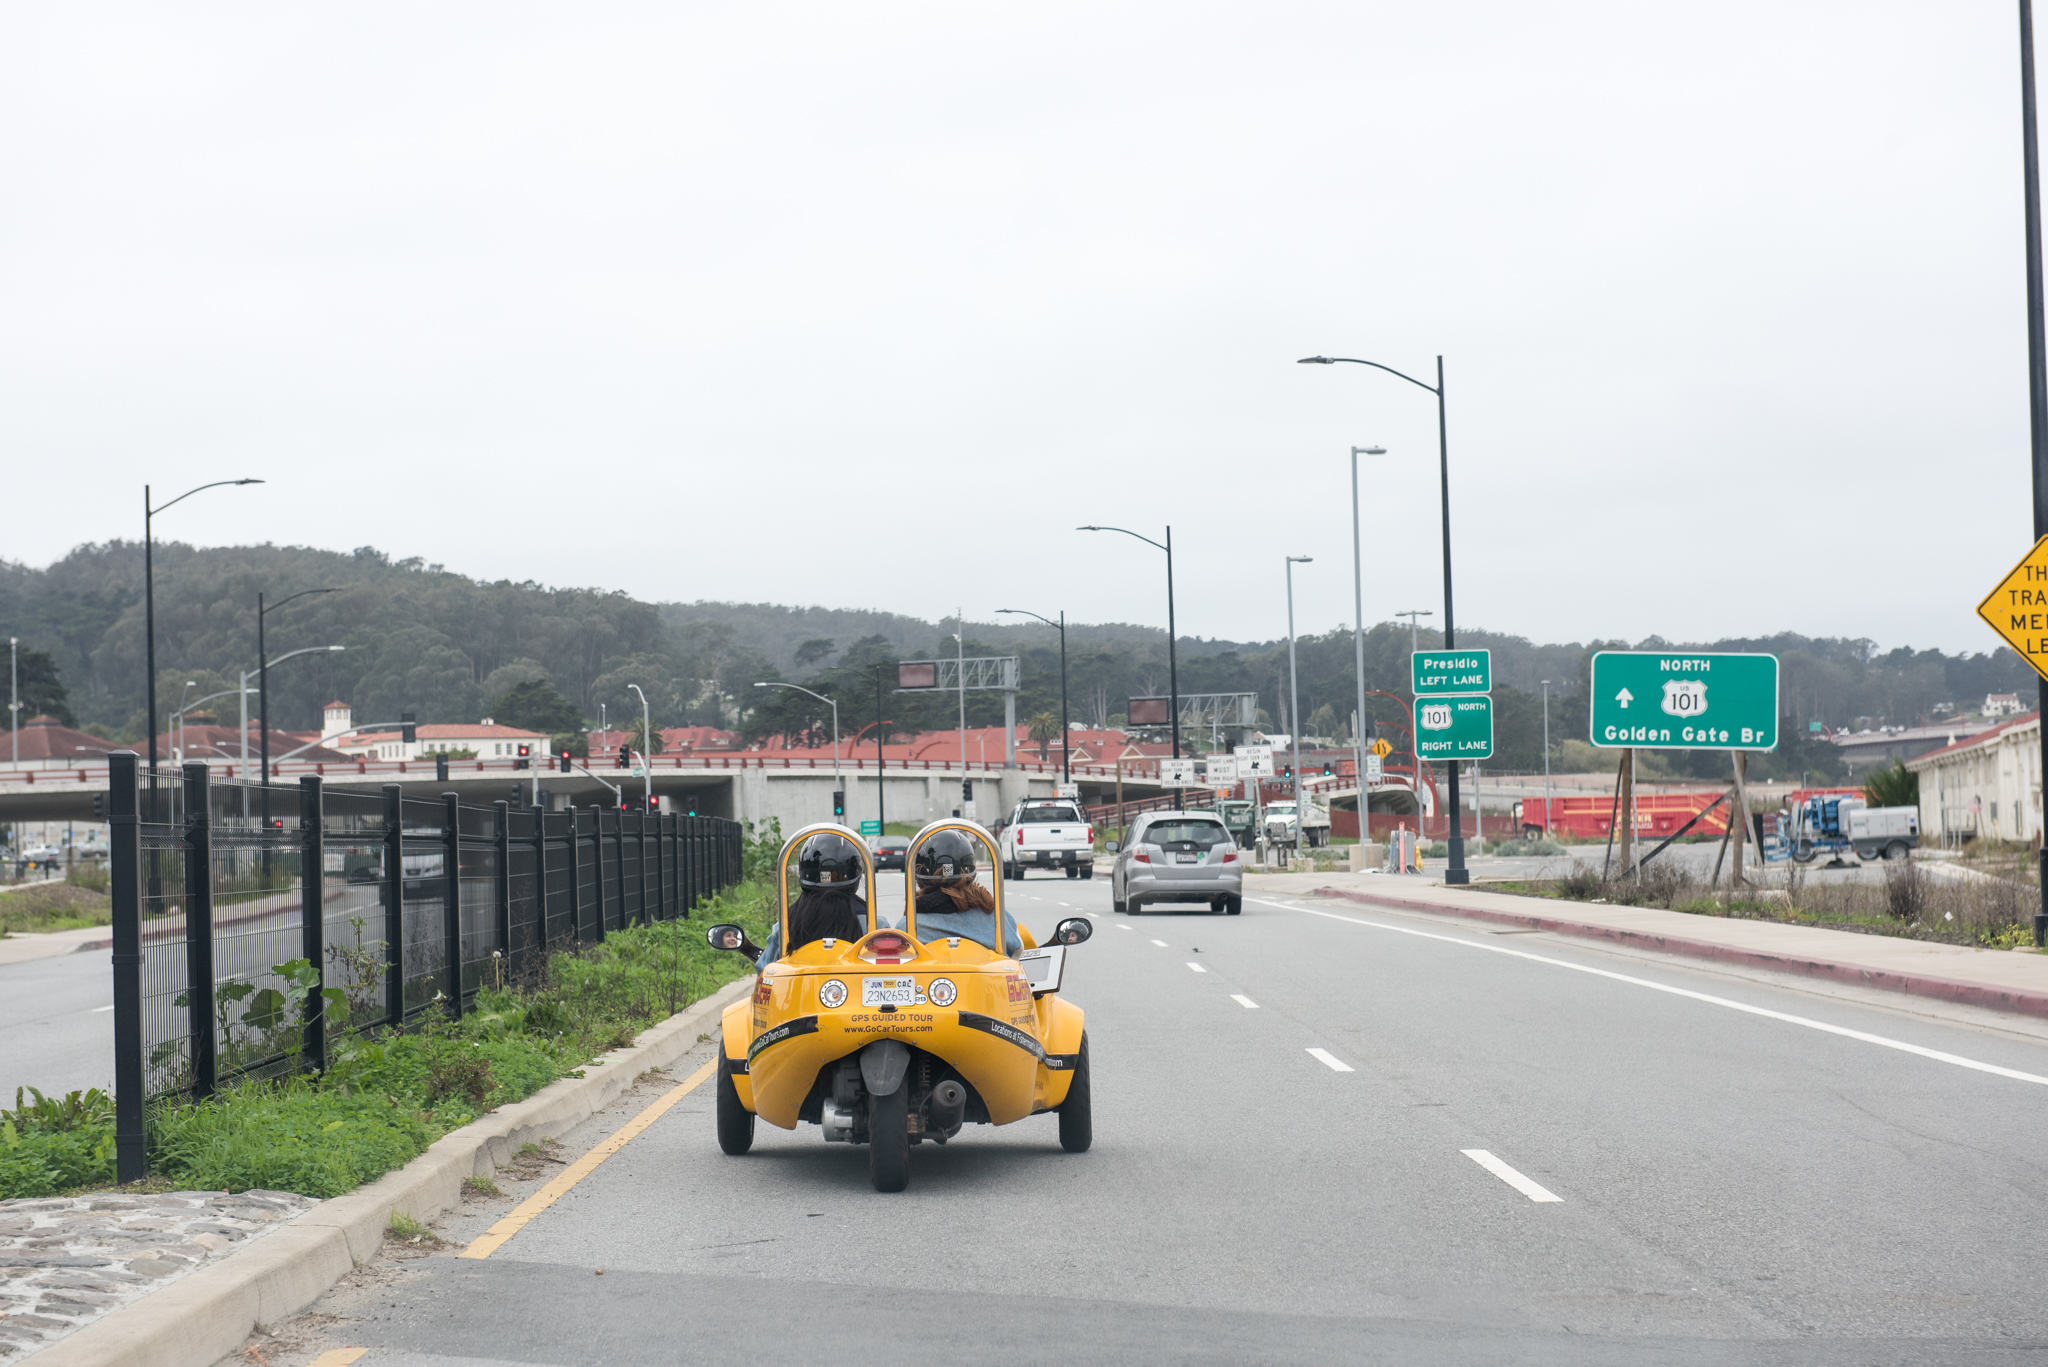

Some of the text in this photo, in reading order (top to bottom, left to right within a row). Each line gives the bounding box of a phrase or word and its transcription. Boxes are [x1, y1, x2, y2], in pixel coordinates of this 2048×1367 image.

[2011, 614, 2048, 630] ME
[1424, 658, 1478, 669] Presidio
[1660, 659, 1710, 671] NORTH
[1420, 675, 1483, 686] LEFT LANE
[1458, 703, 1486, 711] NORTH
[1672, 693, 1698, 710] 101
[1427, 711, 1447, 724] 101
[1604, 725, 1764, 743] Golden Gate Br
[1422, 741, 1487, 751] RIGHT LANE
[897, 980, 911, 988] CAL
[867, 990, 910, 1002] 23N2653
[909, 1014, 933, 1022] TOUR
[844, 1025, 933, 1033] www.GoCarTours.com
[991, 1021, 1012, 1039] Locations
[1013, 1032, 1017, 1041] at
